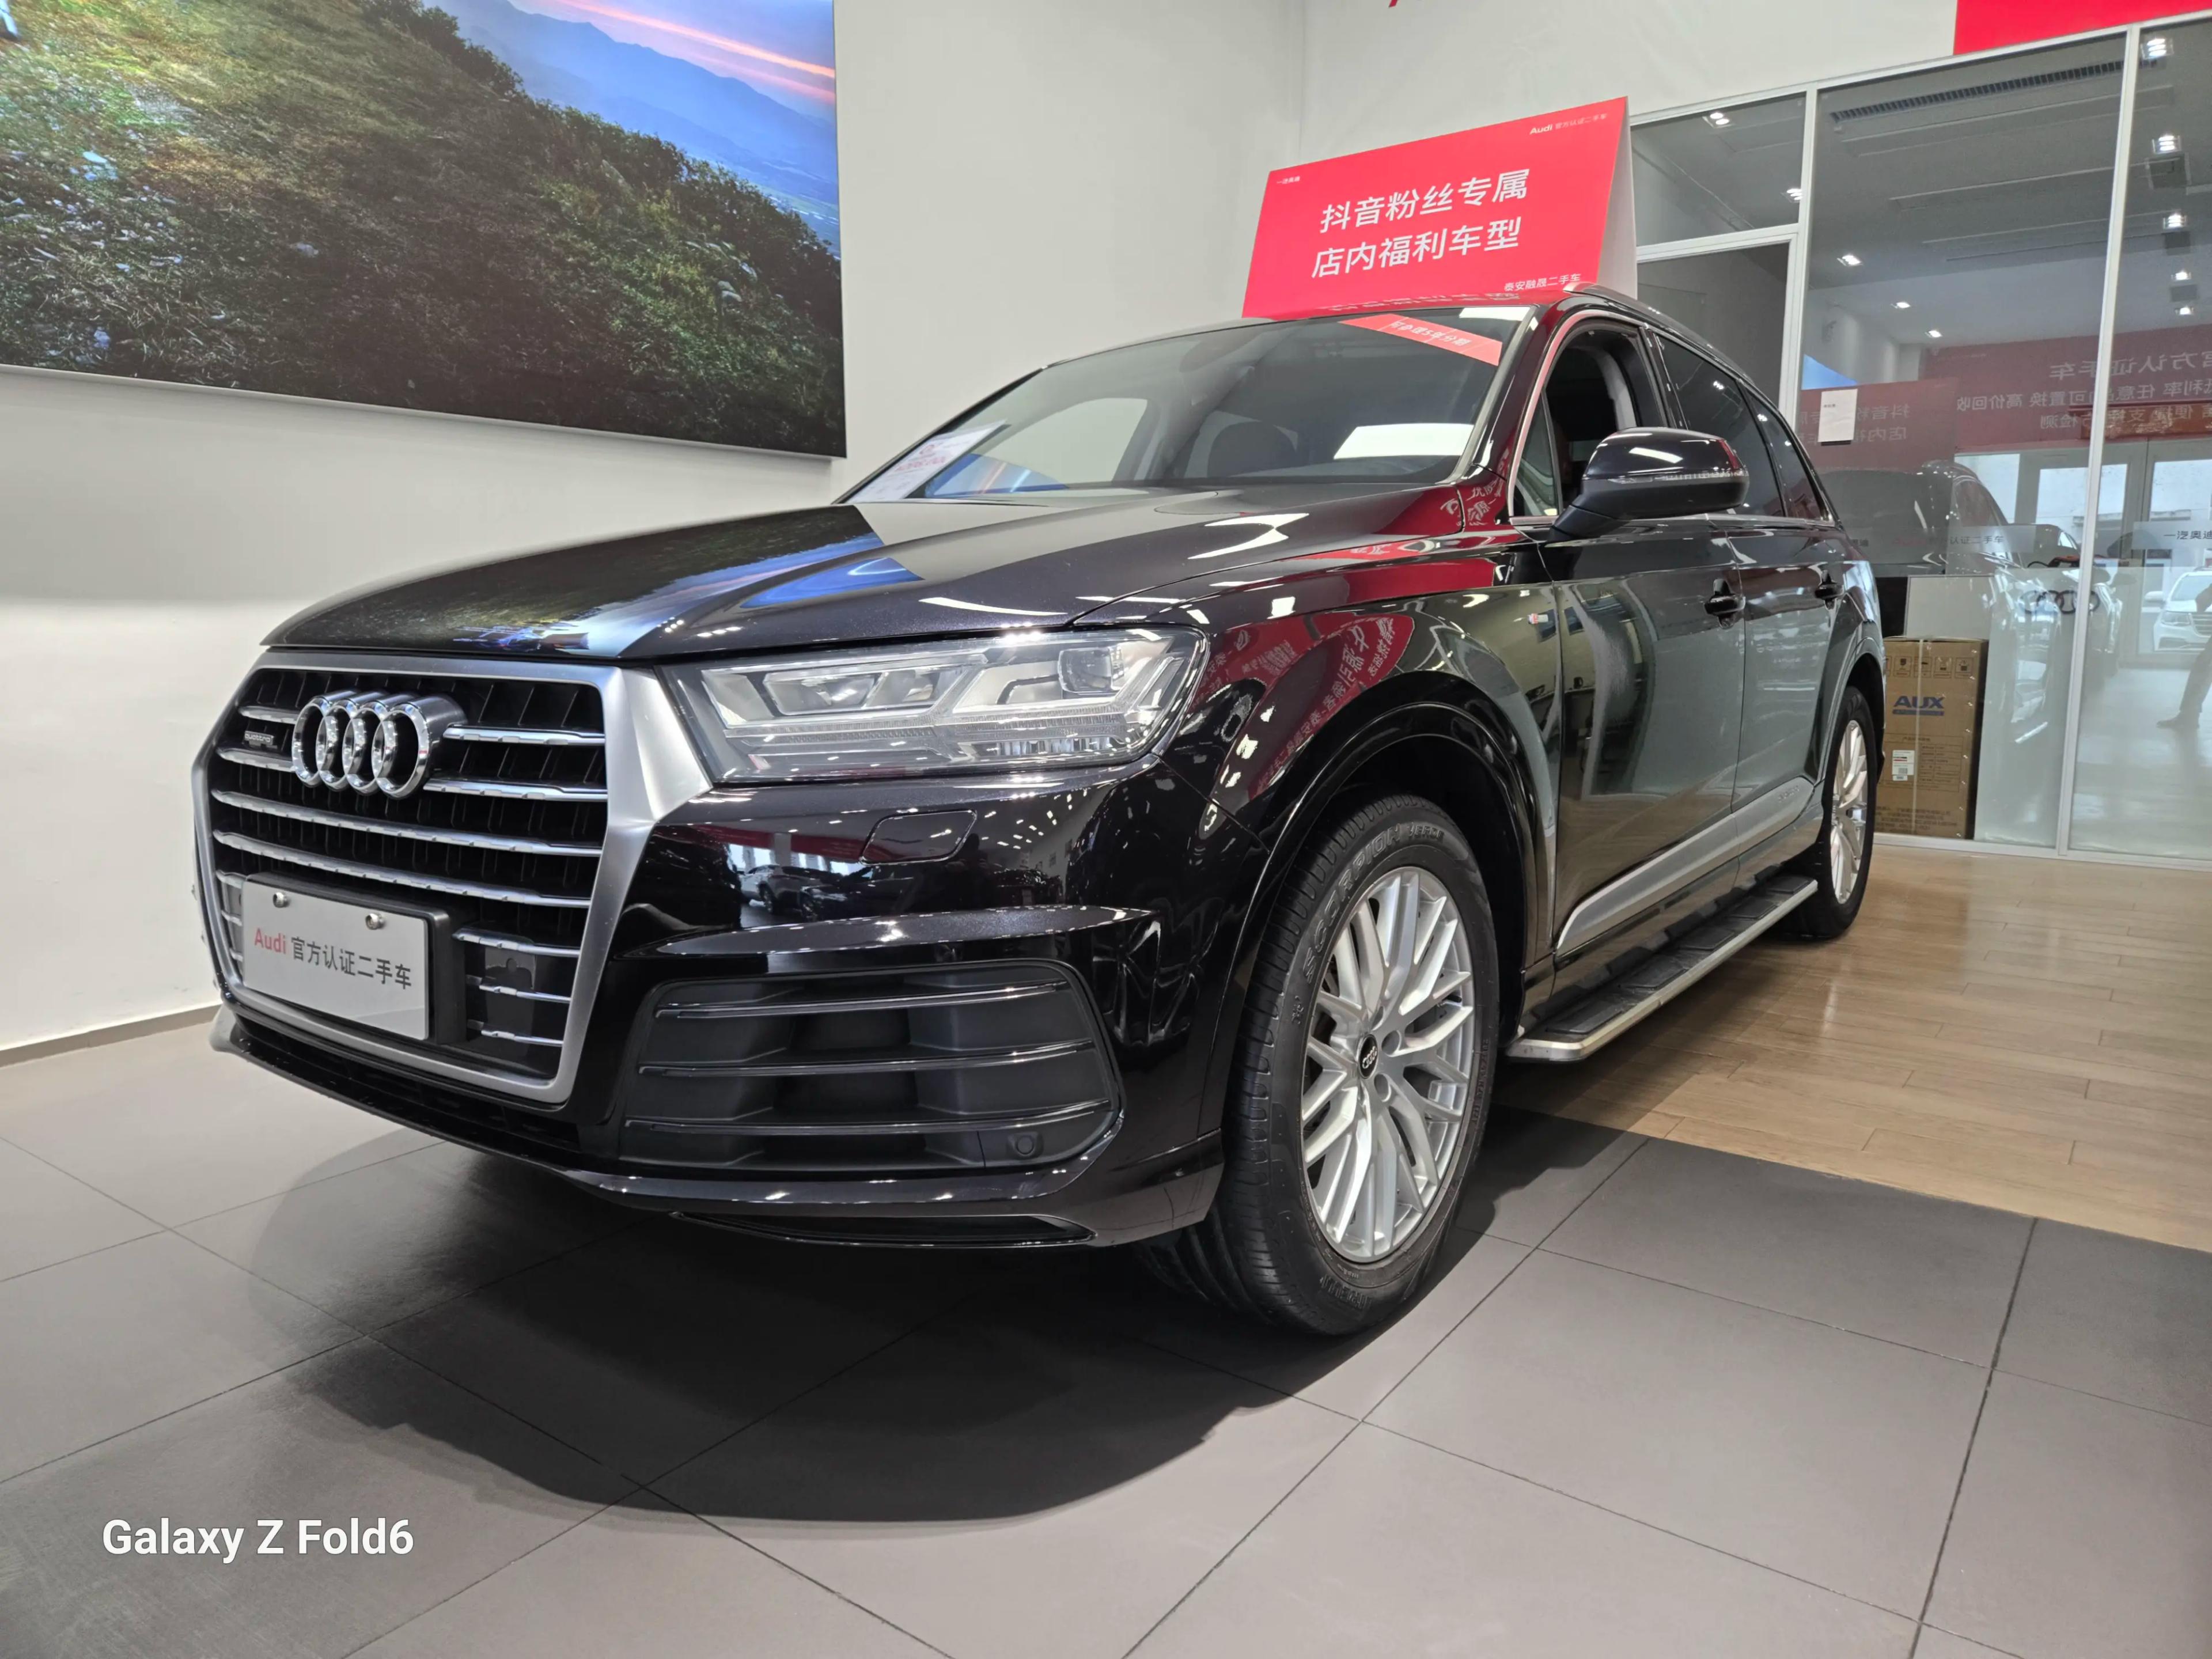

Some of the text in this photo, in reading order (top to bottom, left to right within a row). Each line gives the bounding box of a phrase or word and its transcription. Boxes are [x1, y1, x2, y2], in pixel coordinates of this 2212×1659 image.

[1529, 123, 1553, 135] Audi
[1320, 168, 1530, 234] 抖音粉丝专属
[1311, 215, 1522, 278] 店内福利车型
[1893, 695, 1945, 709] AUX
[254, 927, 412, 990] Audi 官方认证二手车
